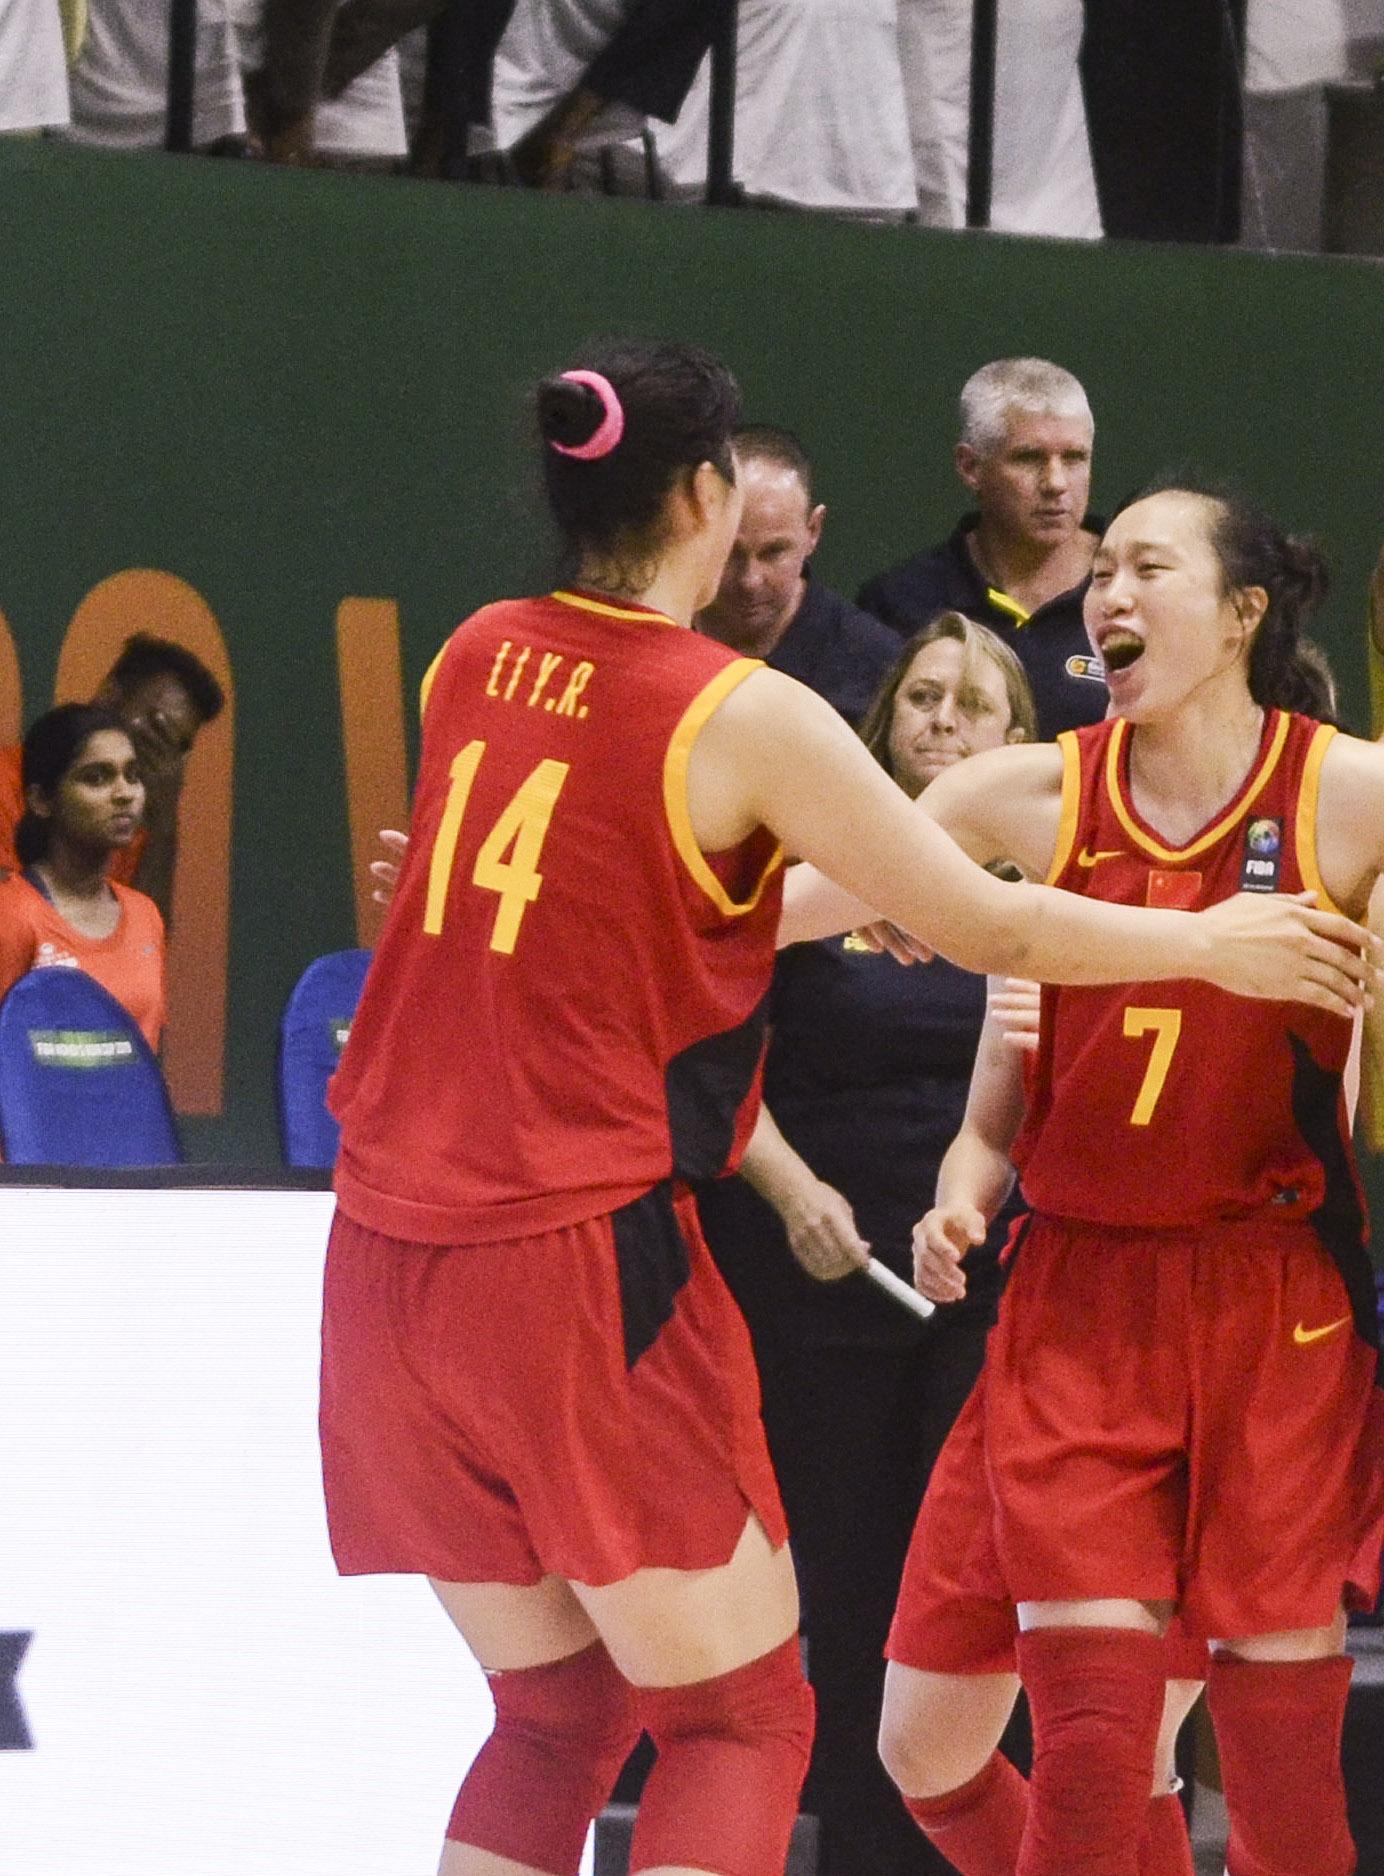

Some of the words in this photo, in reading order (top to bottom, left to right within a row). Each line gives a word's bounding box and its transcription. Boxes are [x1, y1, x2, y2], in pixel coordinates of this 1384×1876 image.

[527, 651, 594, 719] Y.R.
[423, 739, 570, 955] 14
[1123, 1006, 1182, 1126] 7
